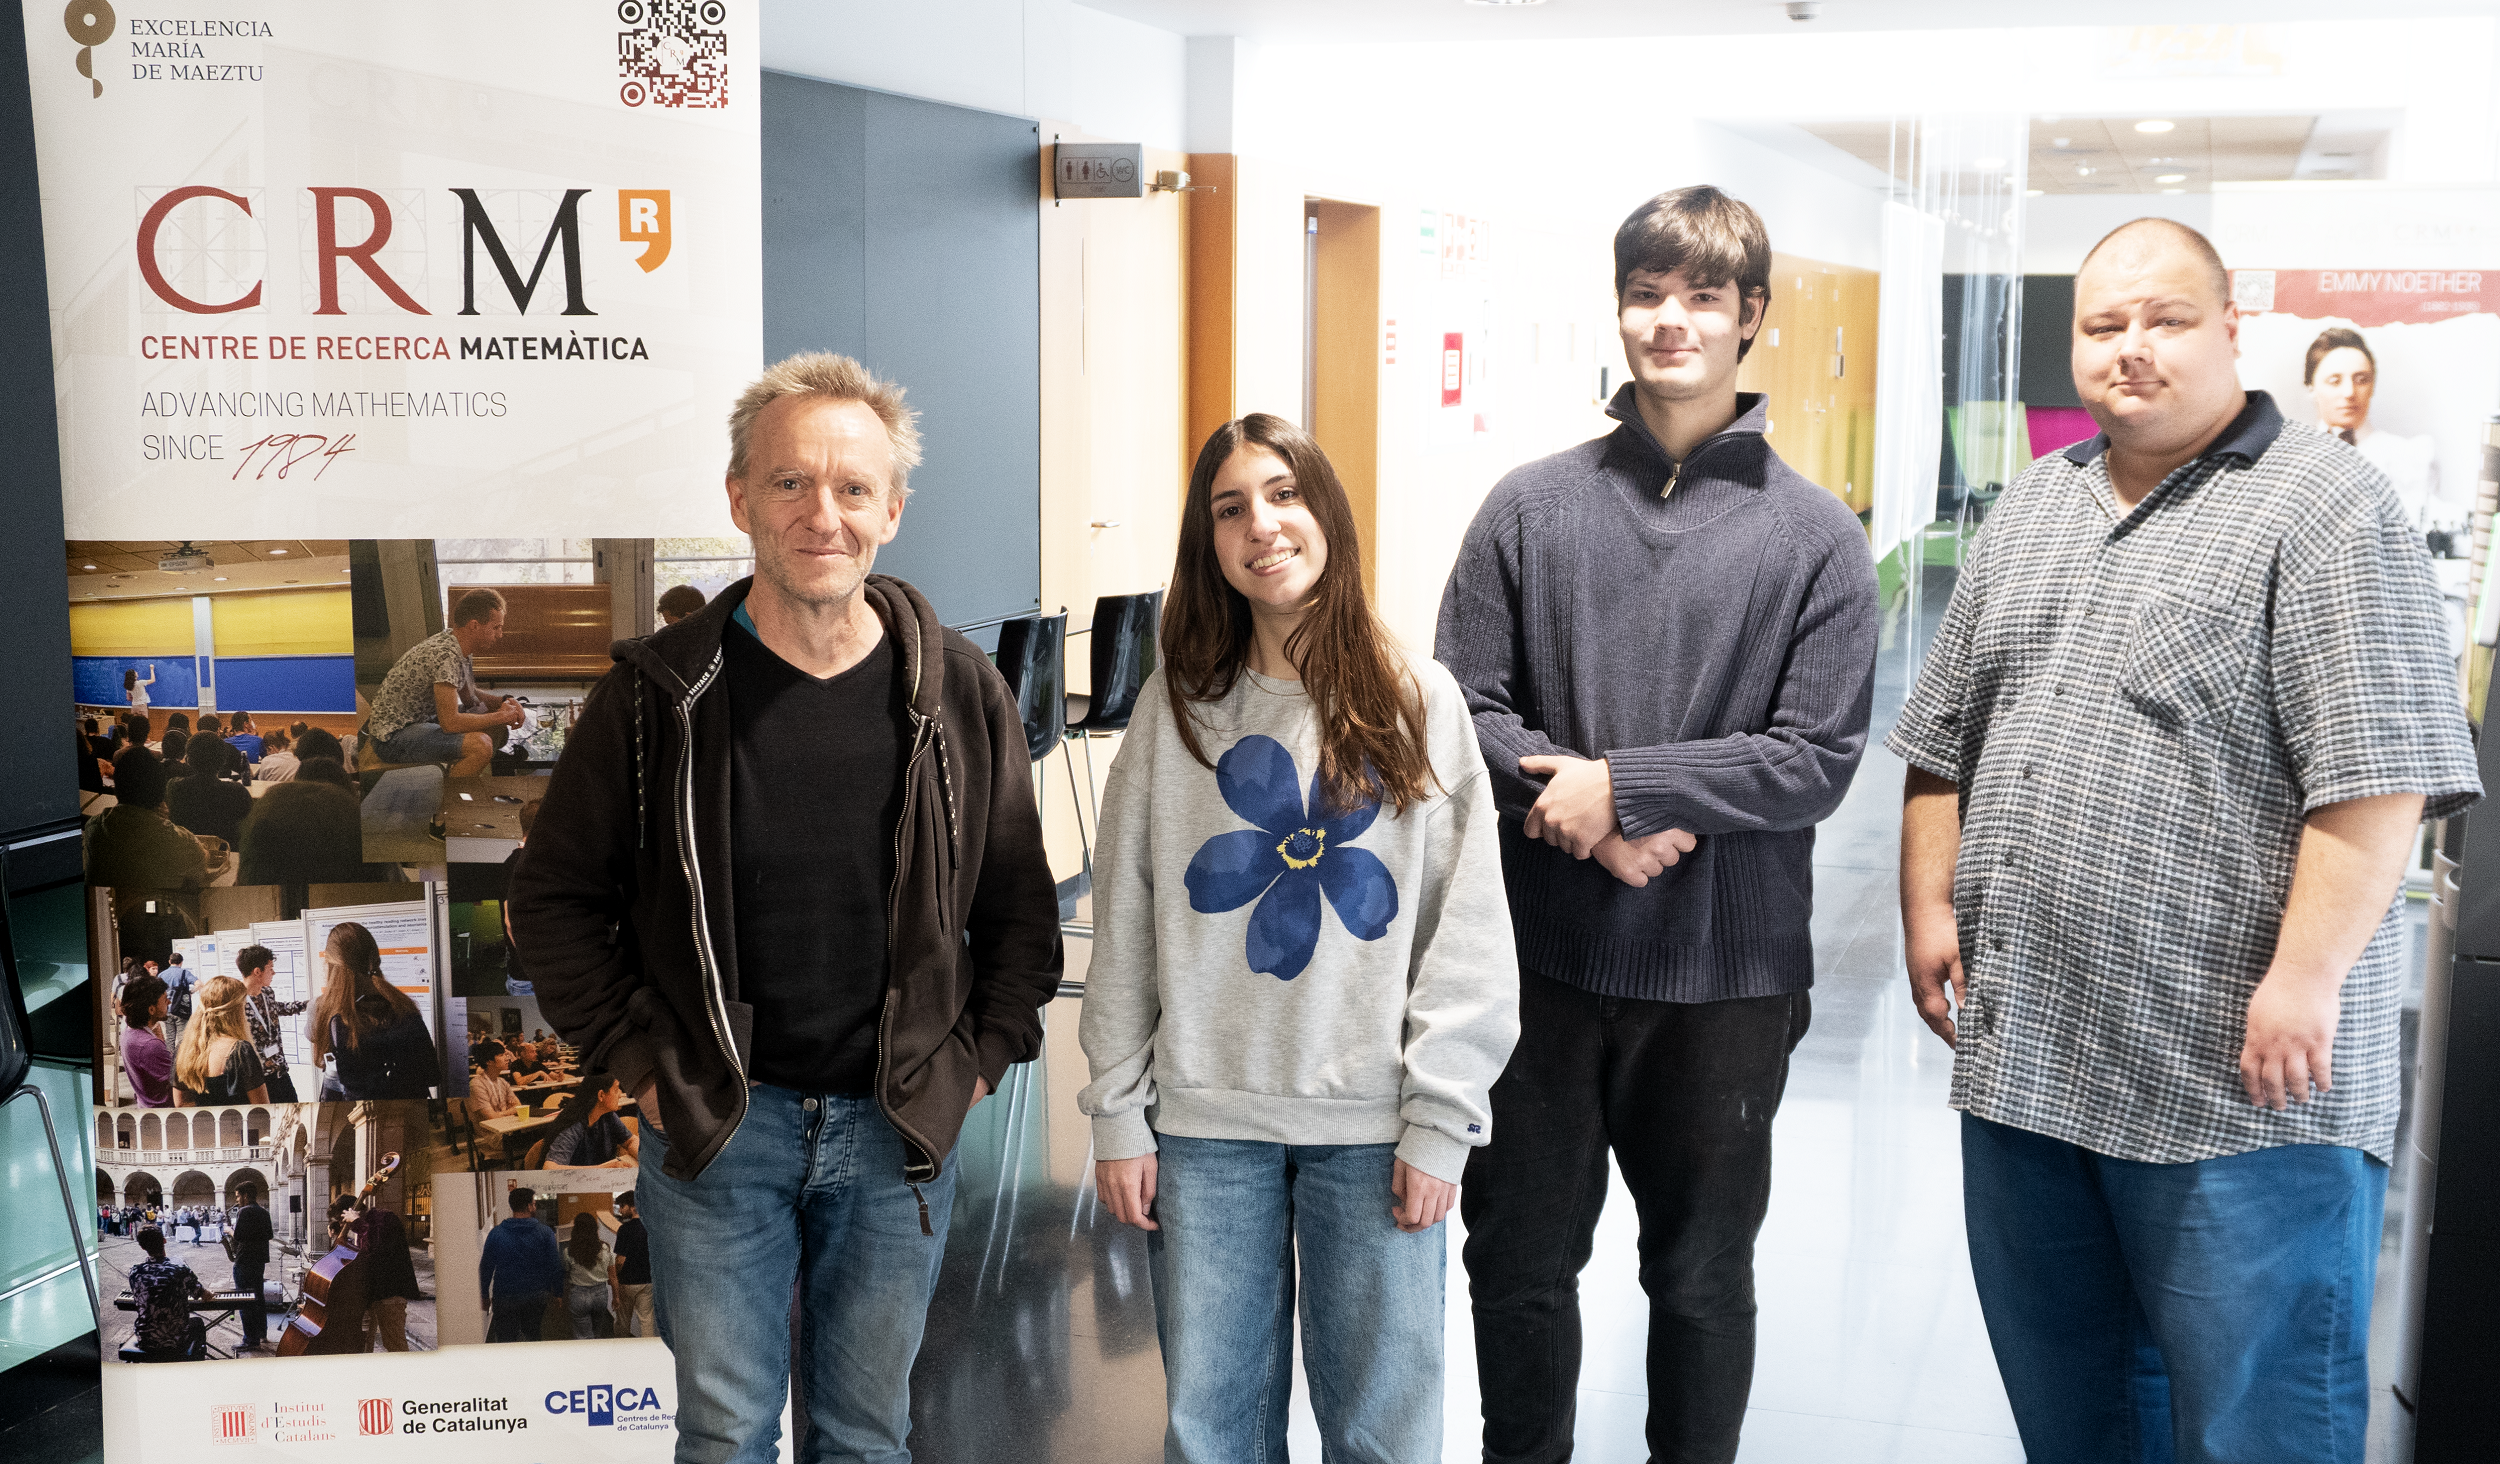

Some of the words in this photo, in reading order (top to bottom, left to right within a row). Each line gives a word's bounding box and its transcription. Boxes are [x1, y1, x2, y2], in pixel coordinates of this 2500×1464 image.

[130, 19, 273, 37] EXCELENCIA
[130, 41, 205, 59] MARÍA
[131, 63, 162, 80] DE
[169, 64, 264, 82] MAEZTU
[1115, 165, 1130, 175] WC
[137, 185, 599, 317] CRM
[2318, 271, 2383, 294] EMMY
[2385, 271, 2482, 294] NOETHER
[141, 335, 259, 360] CENTRE
[268, 335, 307, 360] DE
[316, 336, 451, 360] RECERCA
[460, 329, 650, 361] MATEMÀTICA
[141, 391, 304, 418] ADVANCING
[312, 391, 507, 418] MATHEMATICS
[143, 434, 225, 461] SINCE
[231, 434, 356, 481] 1984
[688, 671, 711, 696] FATFACE
[275, 1401, 324, 1413] Institut
[402, 1397, 508, 1415] Generalitat
[545, 1386, 662, 1415] CERCA
[261, 1414, 327, 1429] d'Estudis
[403, 1419, 427, 1434] de
[432, 1416, 528, 1434] Catalunya
[617, 1415, 648, 1423] Centres
[650, 1414, 660, 1422] de
[629, 1423, 669, 1432] Catalunya
[275, 1429, 336, 1443] Catalans
